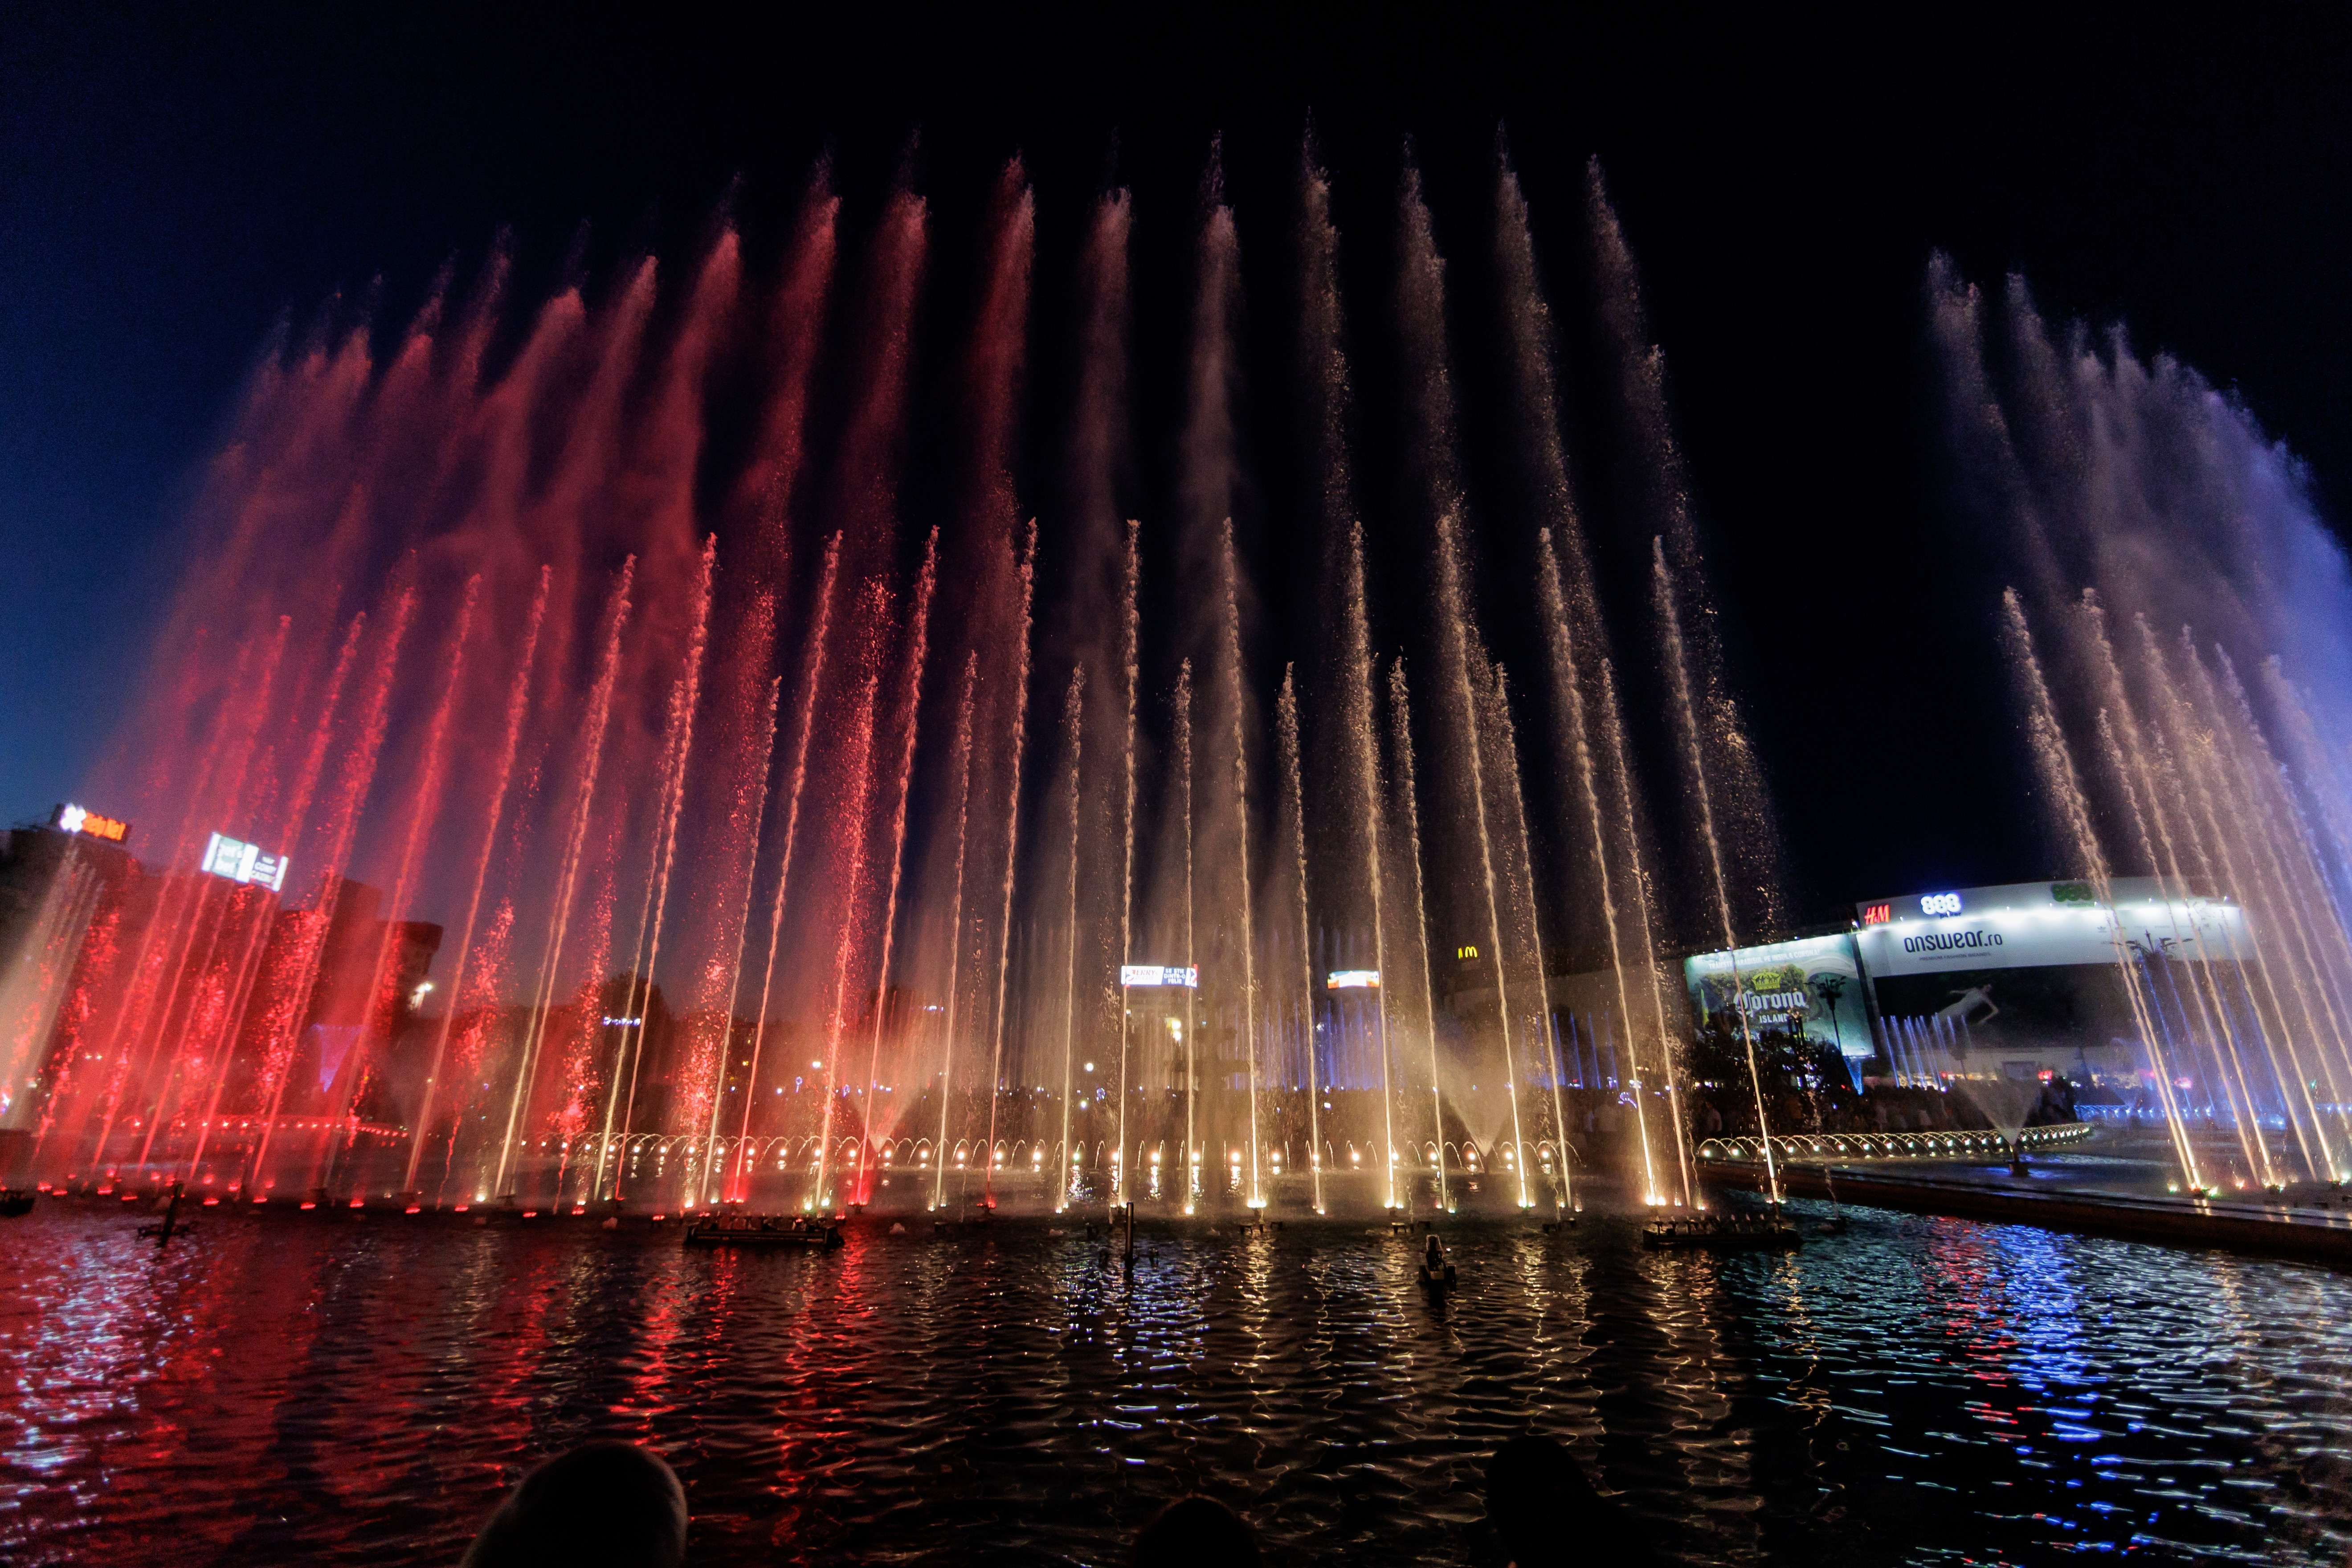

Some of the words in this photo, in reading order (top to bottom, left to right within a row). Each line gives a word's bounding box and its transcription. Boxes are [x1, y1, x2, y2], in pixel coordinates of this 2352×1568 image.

[1864, 904, 1890, 925] H&M
[1920, 894, 1961, 915] 888
[1904, 930, 2003, 952] answear.ro
[1735, 957, 1763, 966] ARADISUL
[1733, 989, 1808, 1018] Corona
